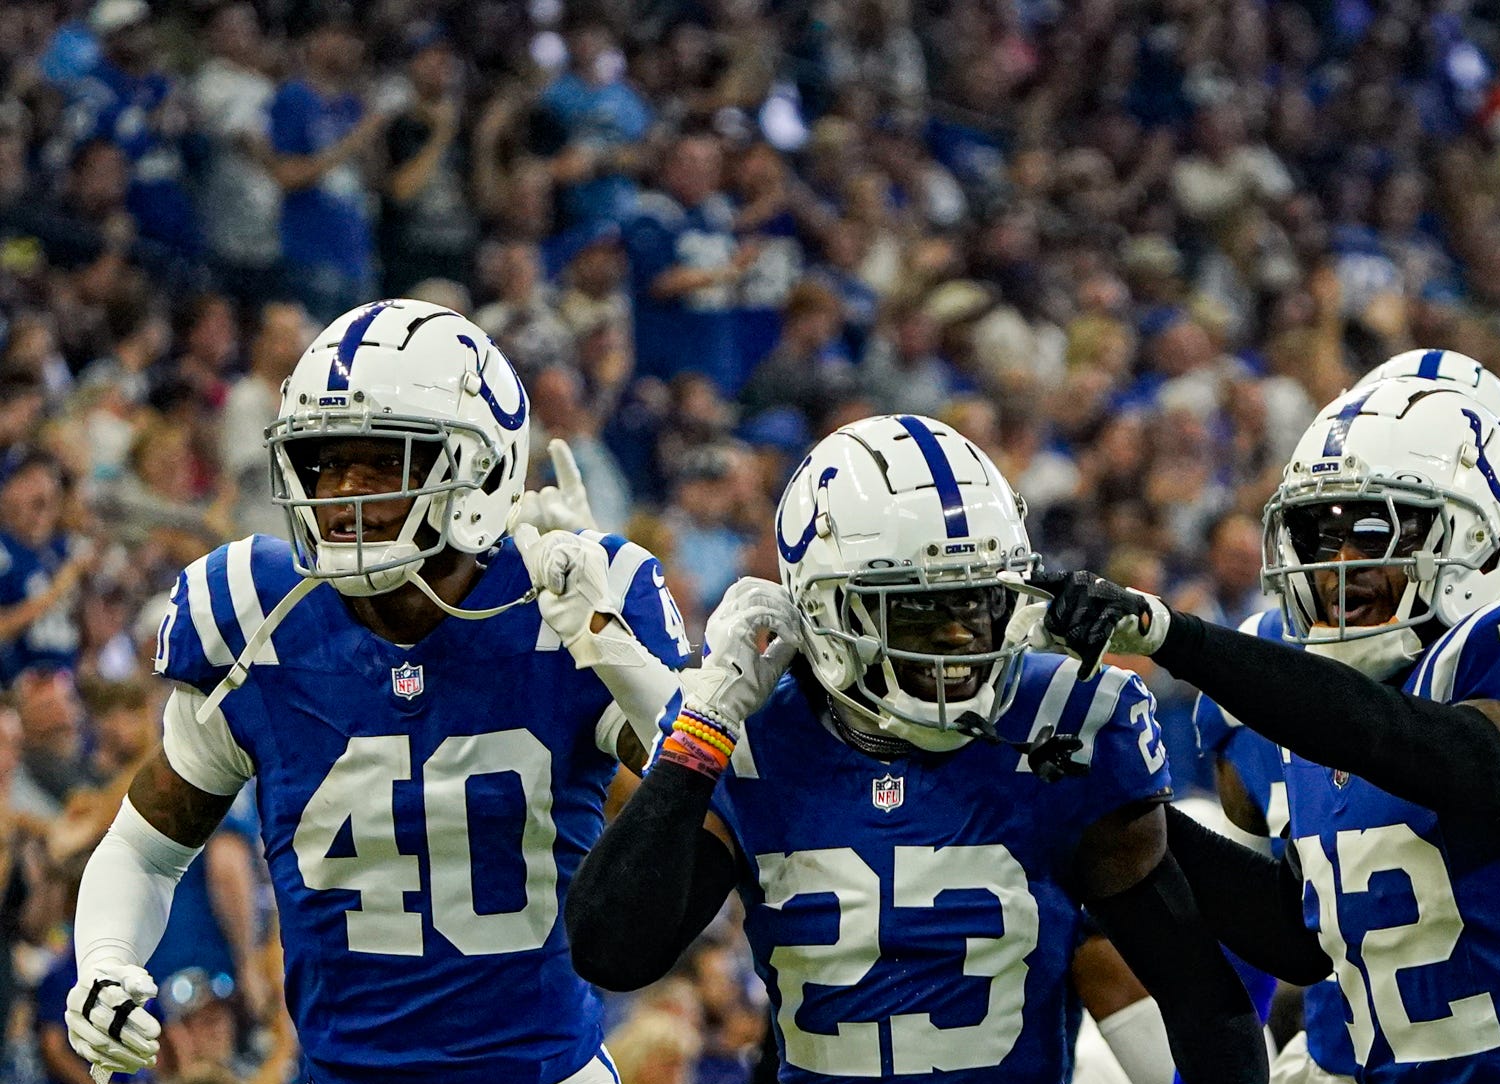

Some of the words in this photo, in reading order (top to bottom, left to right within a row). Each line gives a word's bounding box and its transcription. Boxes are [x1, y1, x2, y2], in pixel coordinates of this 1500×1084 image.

[1312, 462, 1339, 473] COLTS
[945, 544, 976, 554] COLTS
[398, 679, 420, 693] NFL
[1129, 692, 1167, 775] 2
[878, 790, 899, 805] NFL
[292, 727, 559, 957] 40
[755, 843, 1040, 1077] 23
